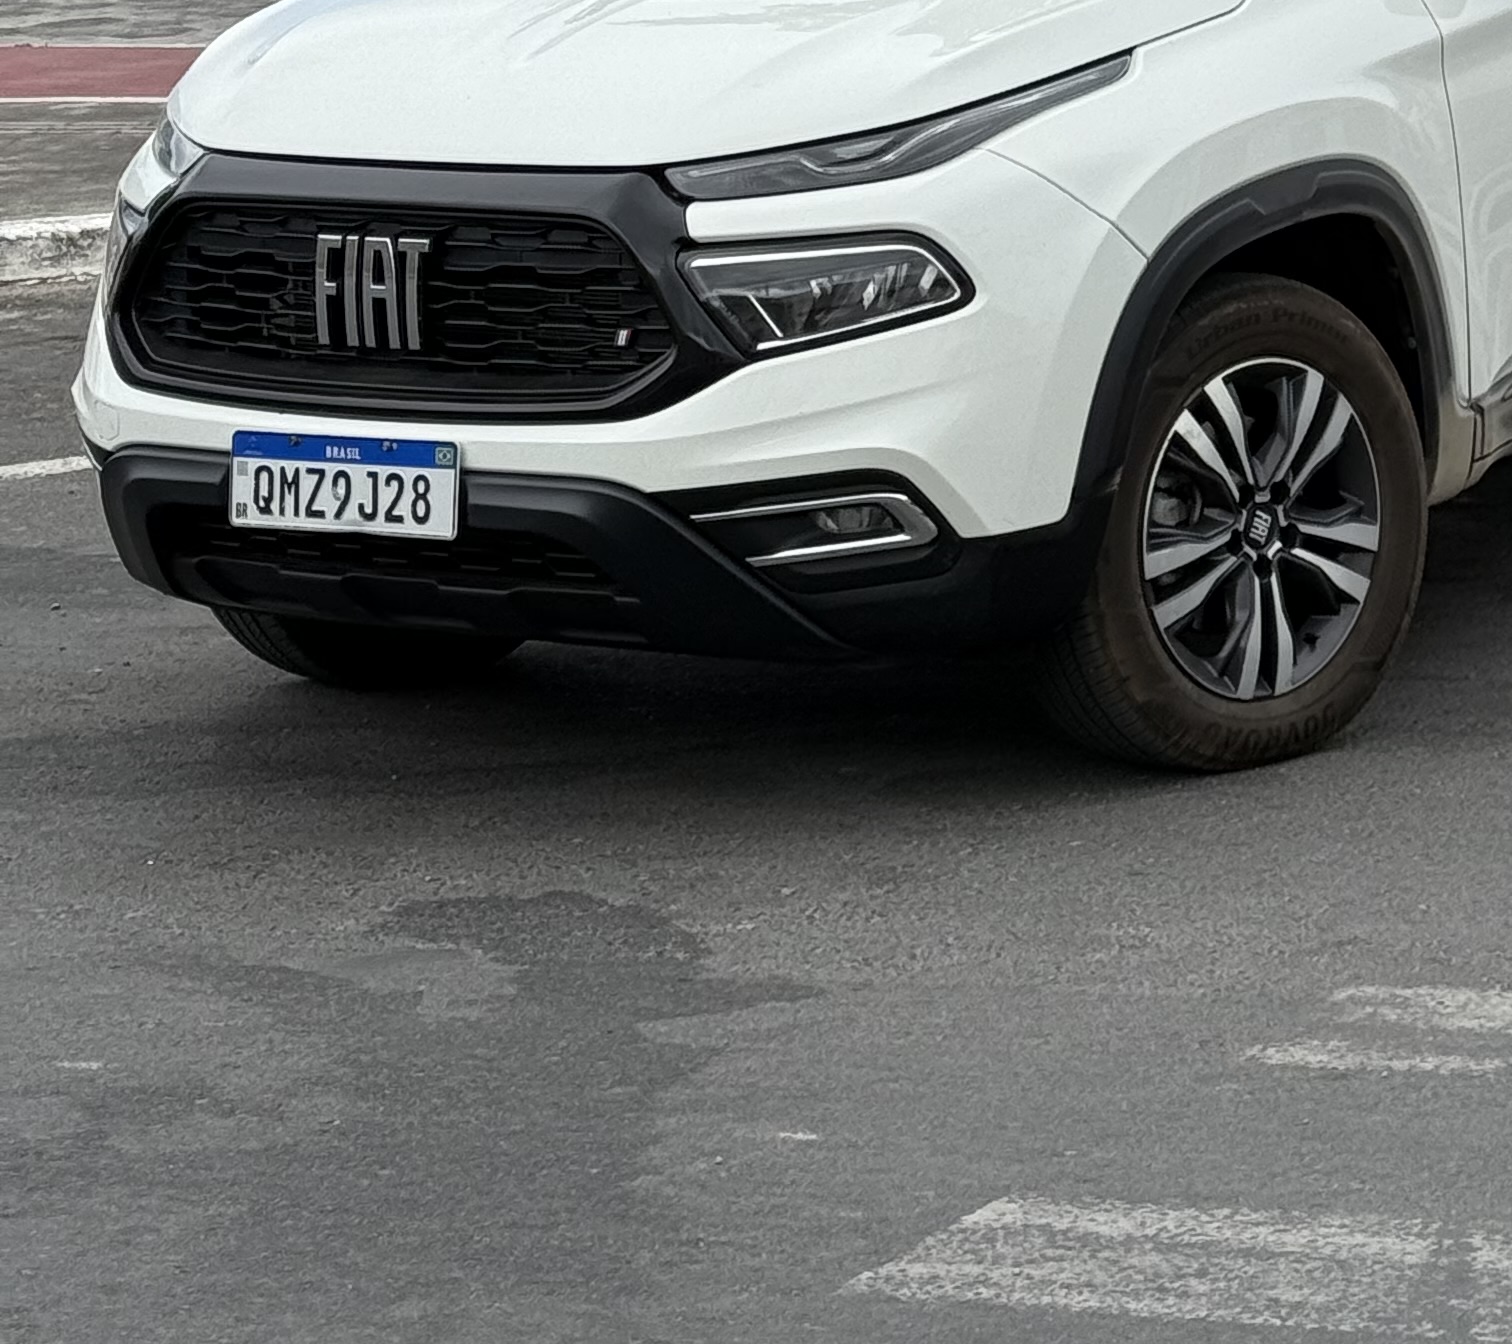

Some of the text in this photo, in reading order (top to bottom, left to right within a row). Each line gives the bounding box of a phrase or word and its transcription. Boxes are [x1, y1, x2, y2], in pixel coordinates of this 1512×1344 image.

[316, 234, 430, 350] FIAT
[325, 445, 362, 460] BRASIL
[235, 502, 249, 520] BR
[253, 464, 431, 526] QMZ9J28
[1249, 509, 1272, 546] FIAT
